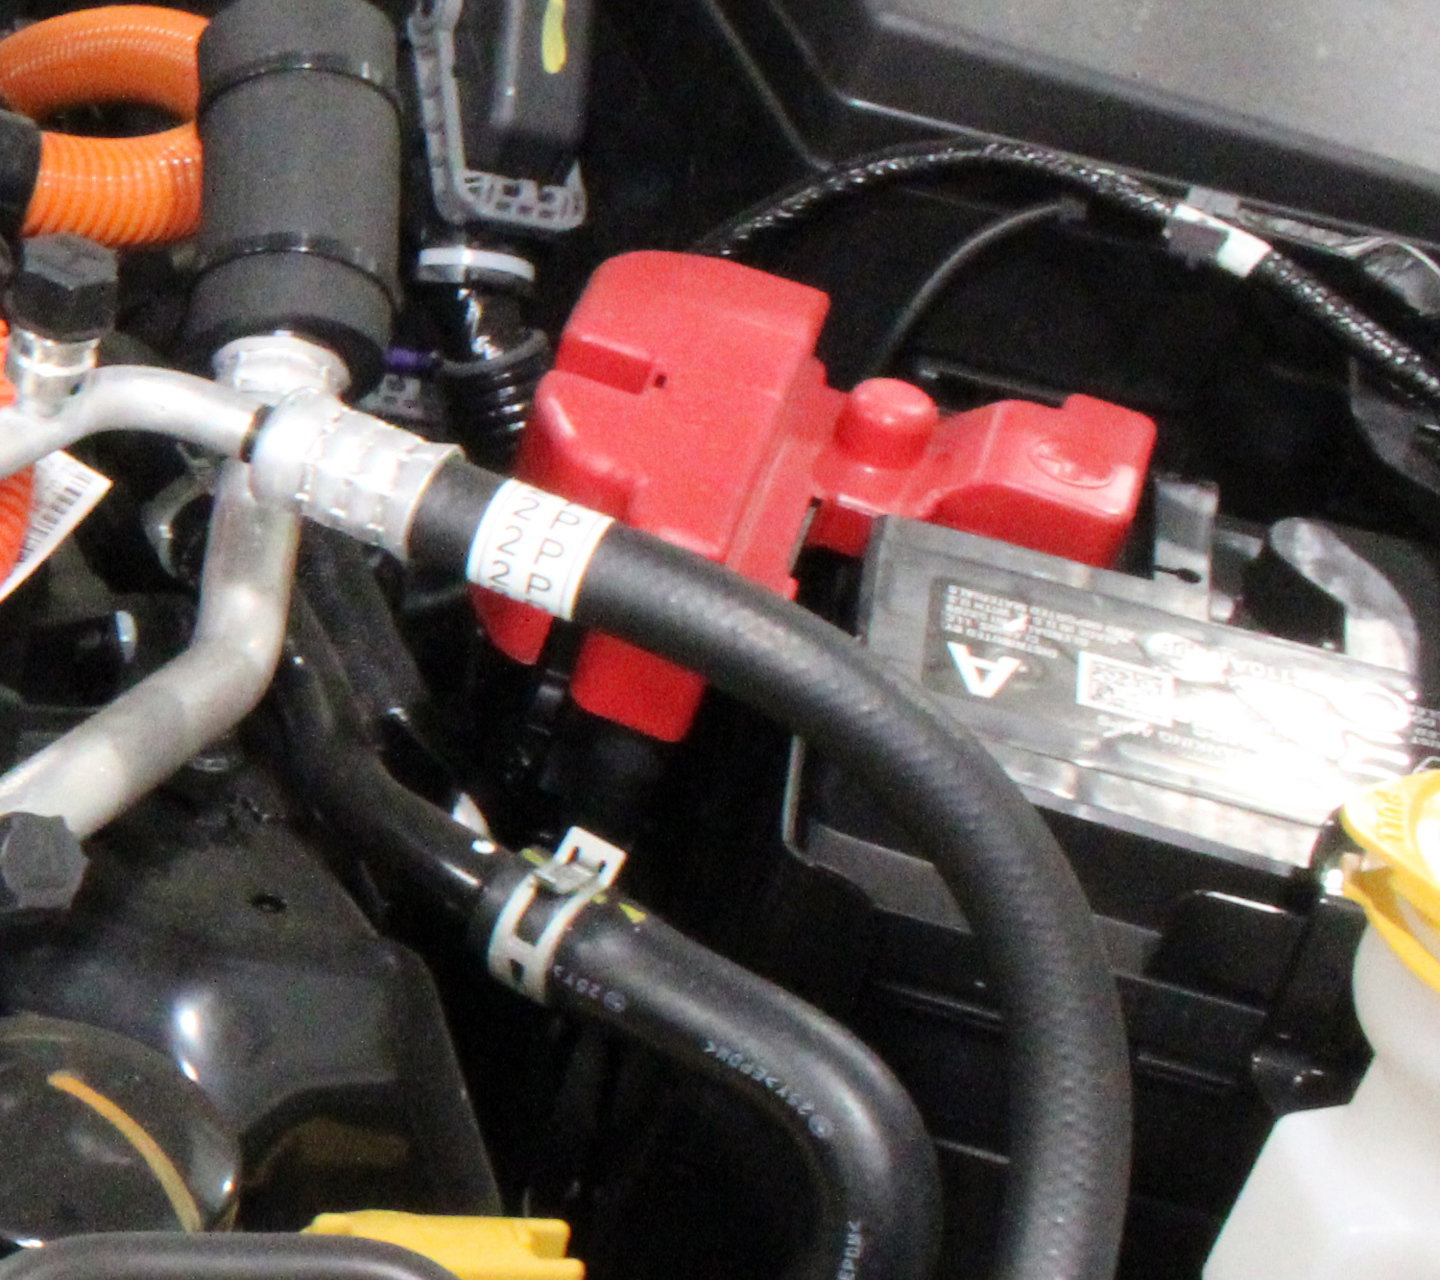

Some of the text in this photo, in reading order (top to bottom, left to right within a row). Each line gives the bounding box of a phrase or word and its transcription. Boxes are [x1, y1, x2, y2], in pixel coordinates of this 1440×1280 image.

[496, 525, 565, 565] 2 P
[489, 559, 552, 595] 2 P
